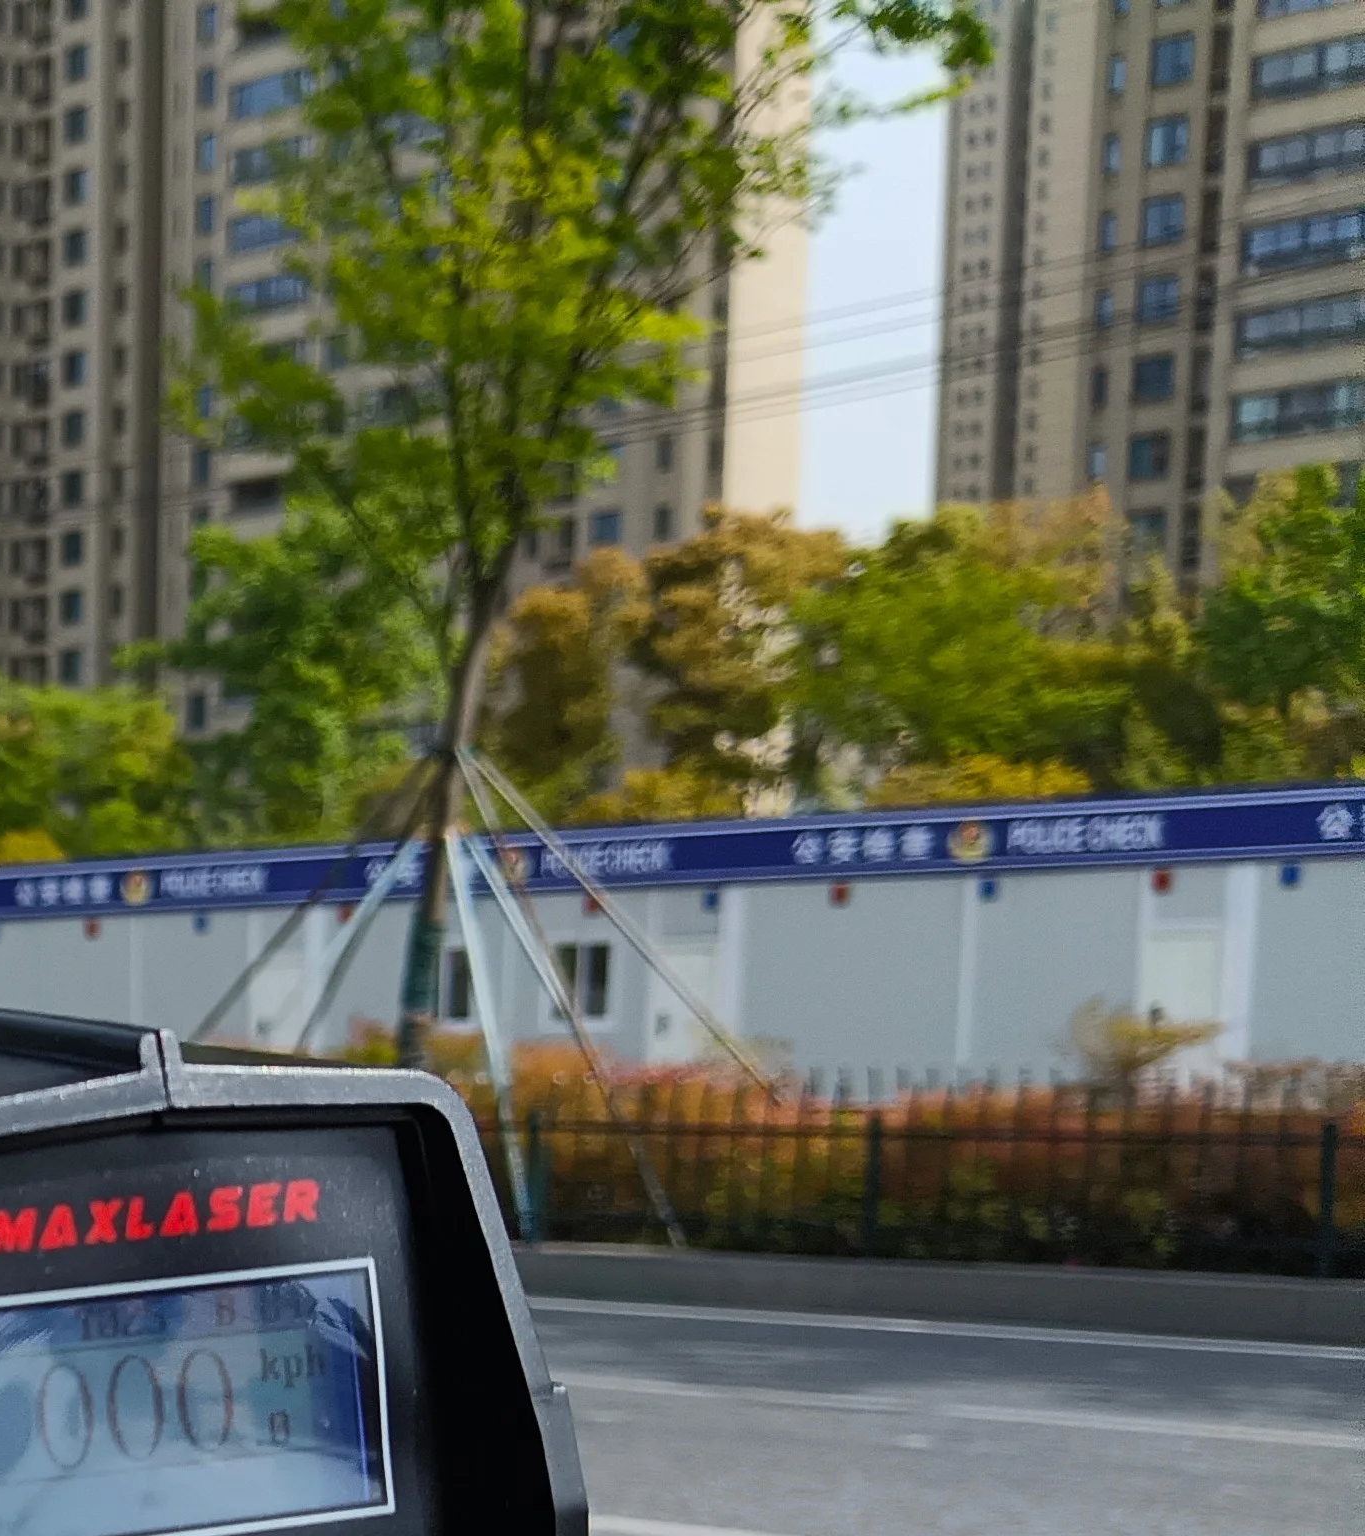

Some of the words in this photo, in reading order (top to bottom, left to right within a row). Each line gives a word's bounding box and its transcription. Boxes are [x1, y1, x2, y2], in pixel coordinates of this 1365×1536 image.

[1007, 818, 1087, 854] POLICE
[1088, 813, 1165, 851] CHECK
[35, 1348, 235, 1470] 000
[259, 1344, 329, 1390] kph
